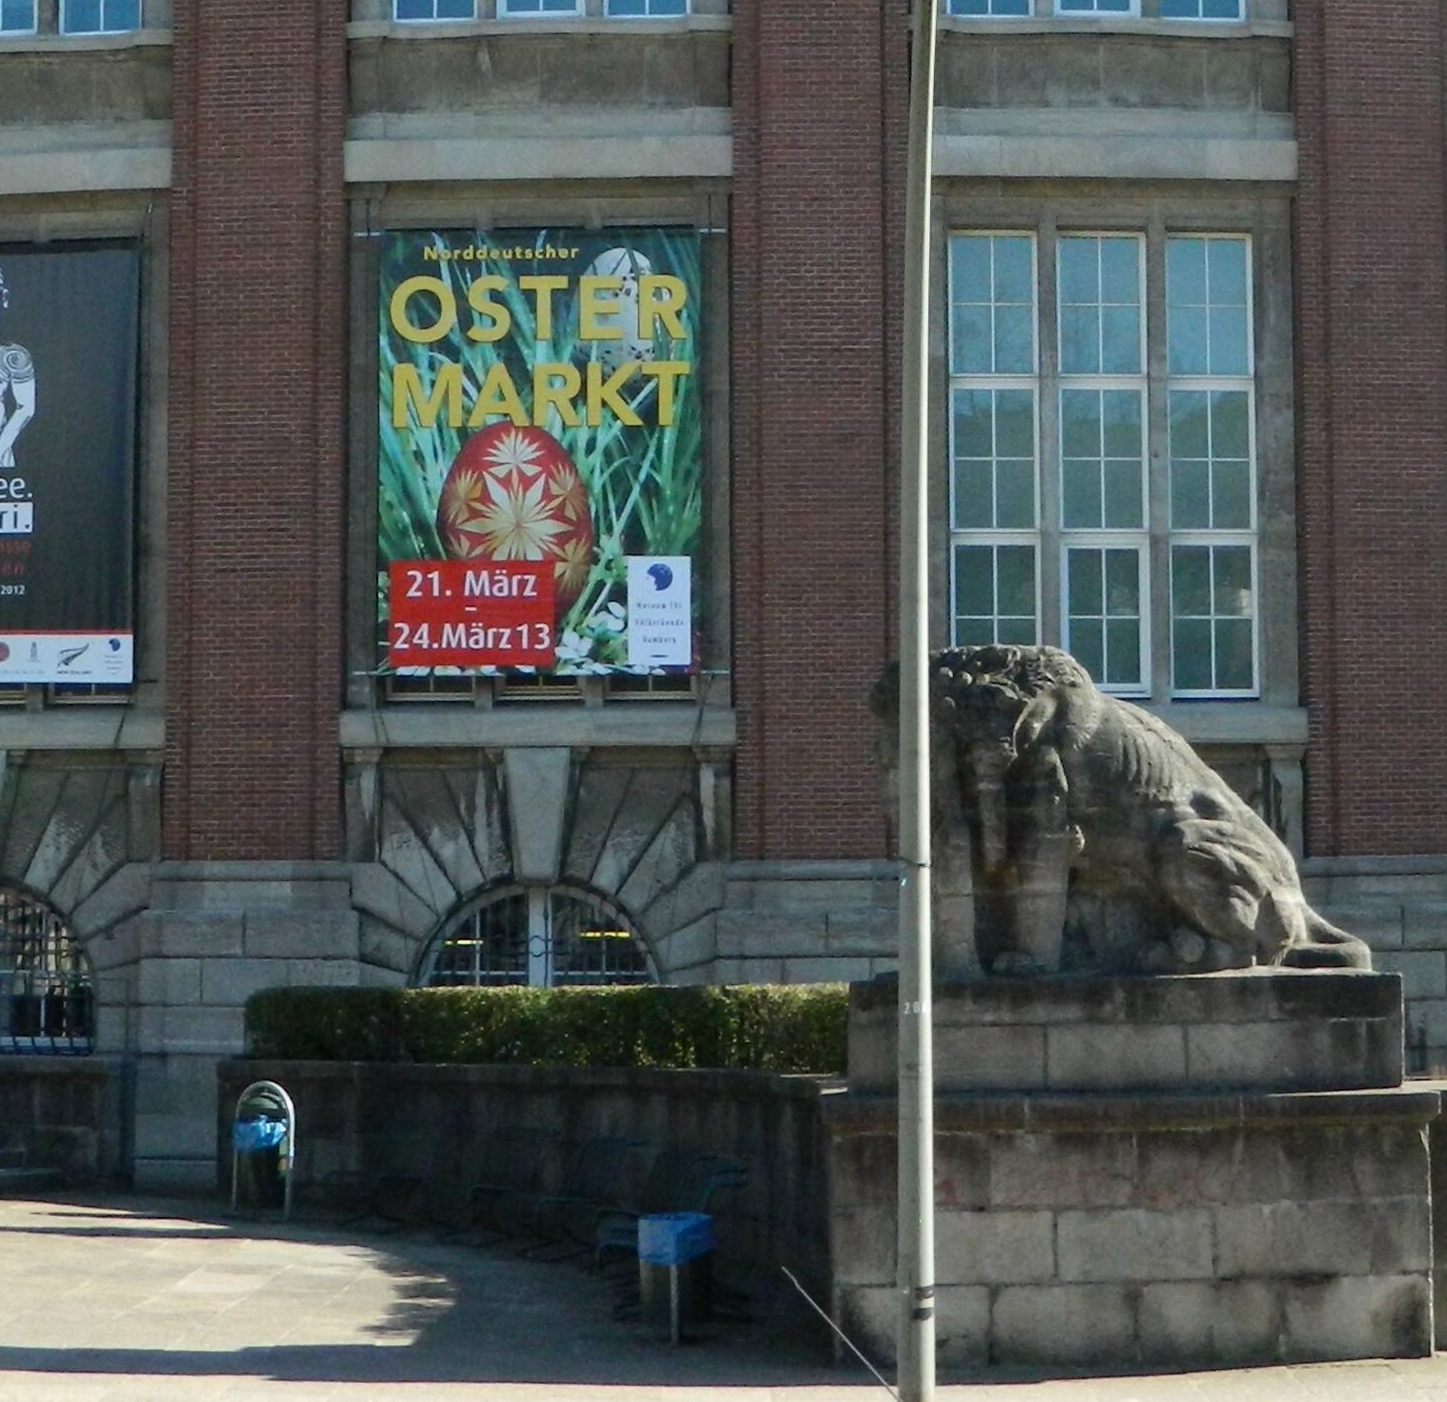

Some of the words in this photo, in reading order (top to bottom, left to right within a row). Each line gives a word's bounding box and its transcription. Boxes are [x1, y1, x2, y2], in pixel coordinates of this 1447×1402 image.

[423, 246, 579, 261] Norddeutscher
[389, 274, 688, 344] OSTER
[392, 361, 691, 428] MARKT
[1, 584, 25, 595] 2012
[406, 570, 452, 597] 21.
[464, 569, 538, 597] März
